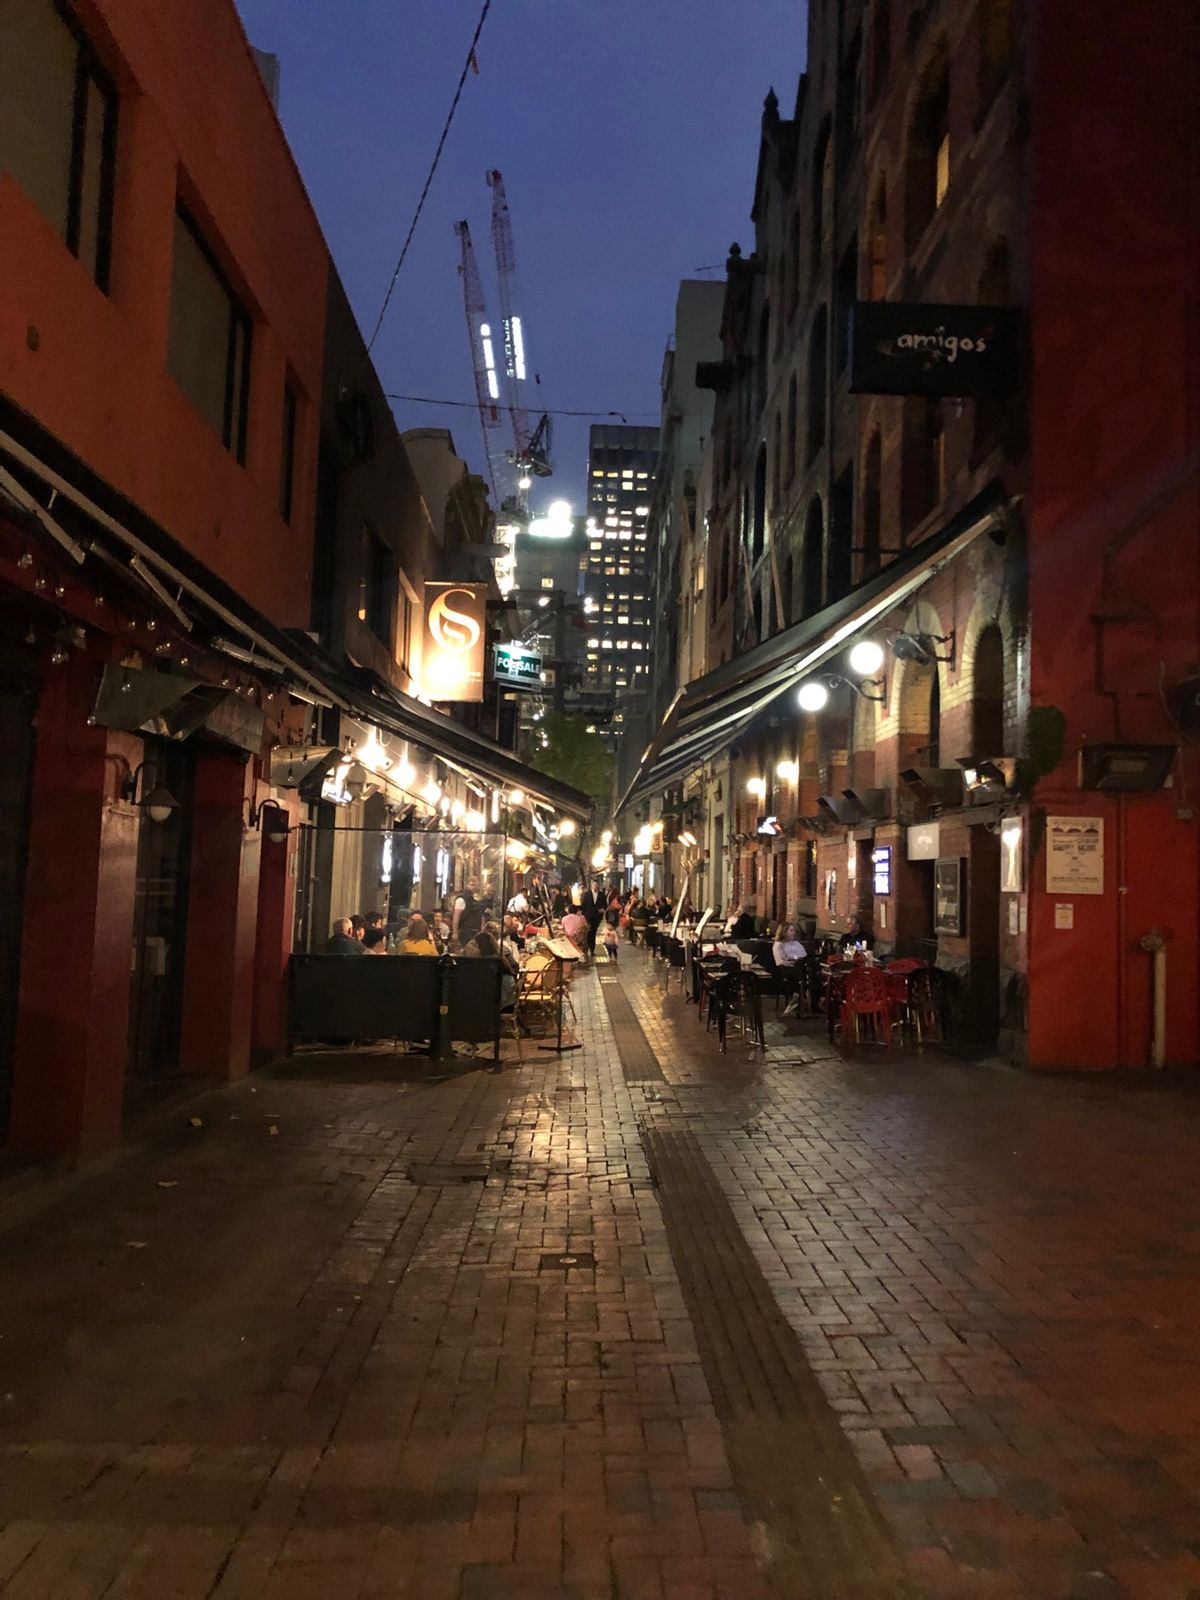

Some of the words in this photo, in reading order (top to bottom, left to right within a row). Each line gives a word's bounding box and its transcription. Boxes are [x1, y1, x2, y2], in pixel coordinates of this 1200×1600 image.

[896, 325, 988, 363] amigos
[497, 656, 517, 669] FO
[518, 660, 541, 673] SALE
